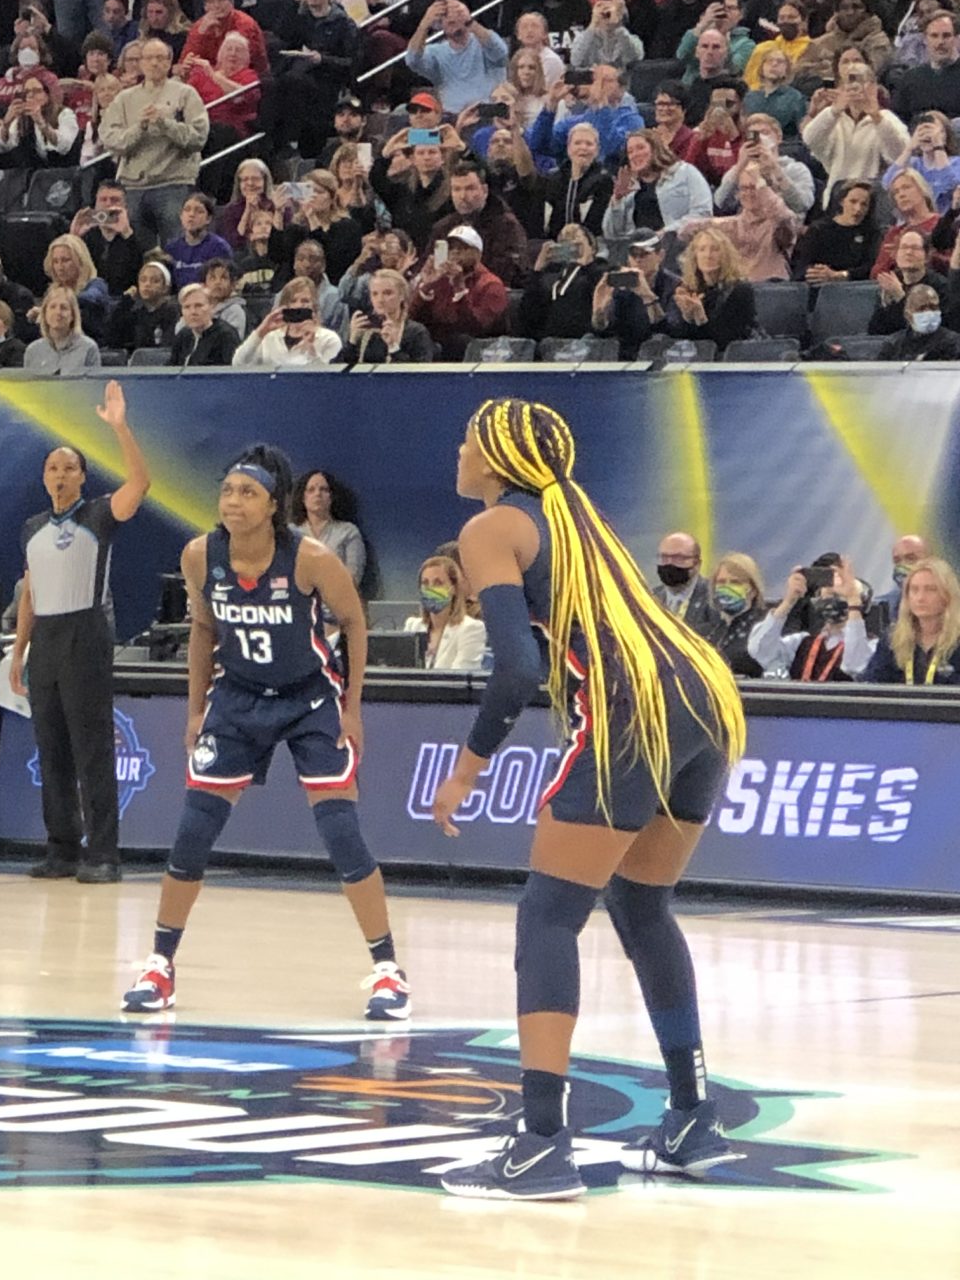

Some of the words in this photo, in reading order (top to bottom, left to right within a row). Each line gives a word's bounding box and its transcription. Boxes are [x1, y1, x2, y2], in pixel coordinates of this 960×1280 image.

[212, 601, 294, 624] UCONN
[235, 629, 273, 664] 13
[115, 756, 141, 782] UR
[705, 758, 918, 843] SKIES
